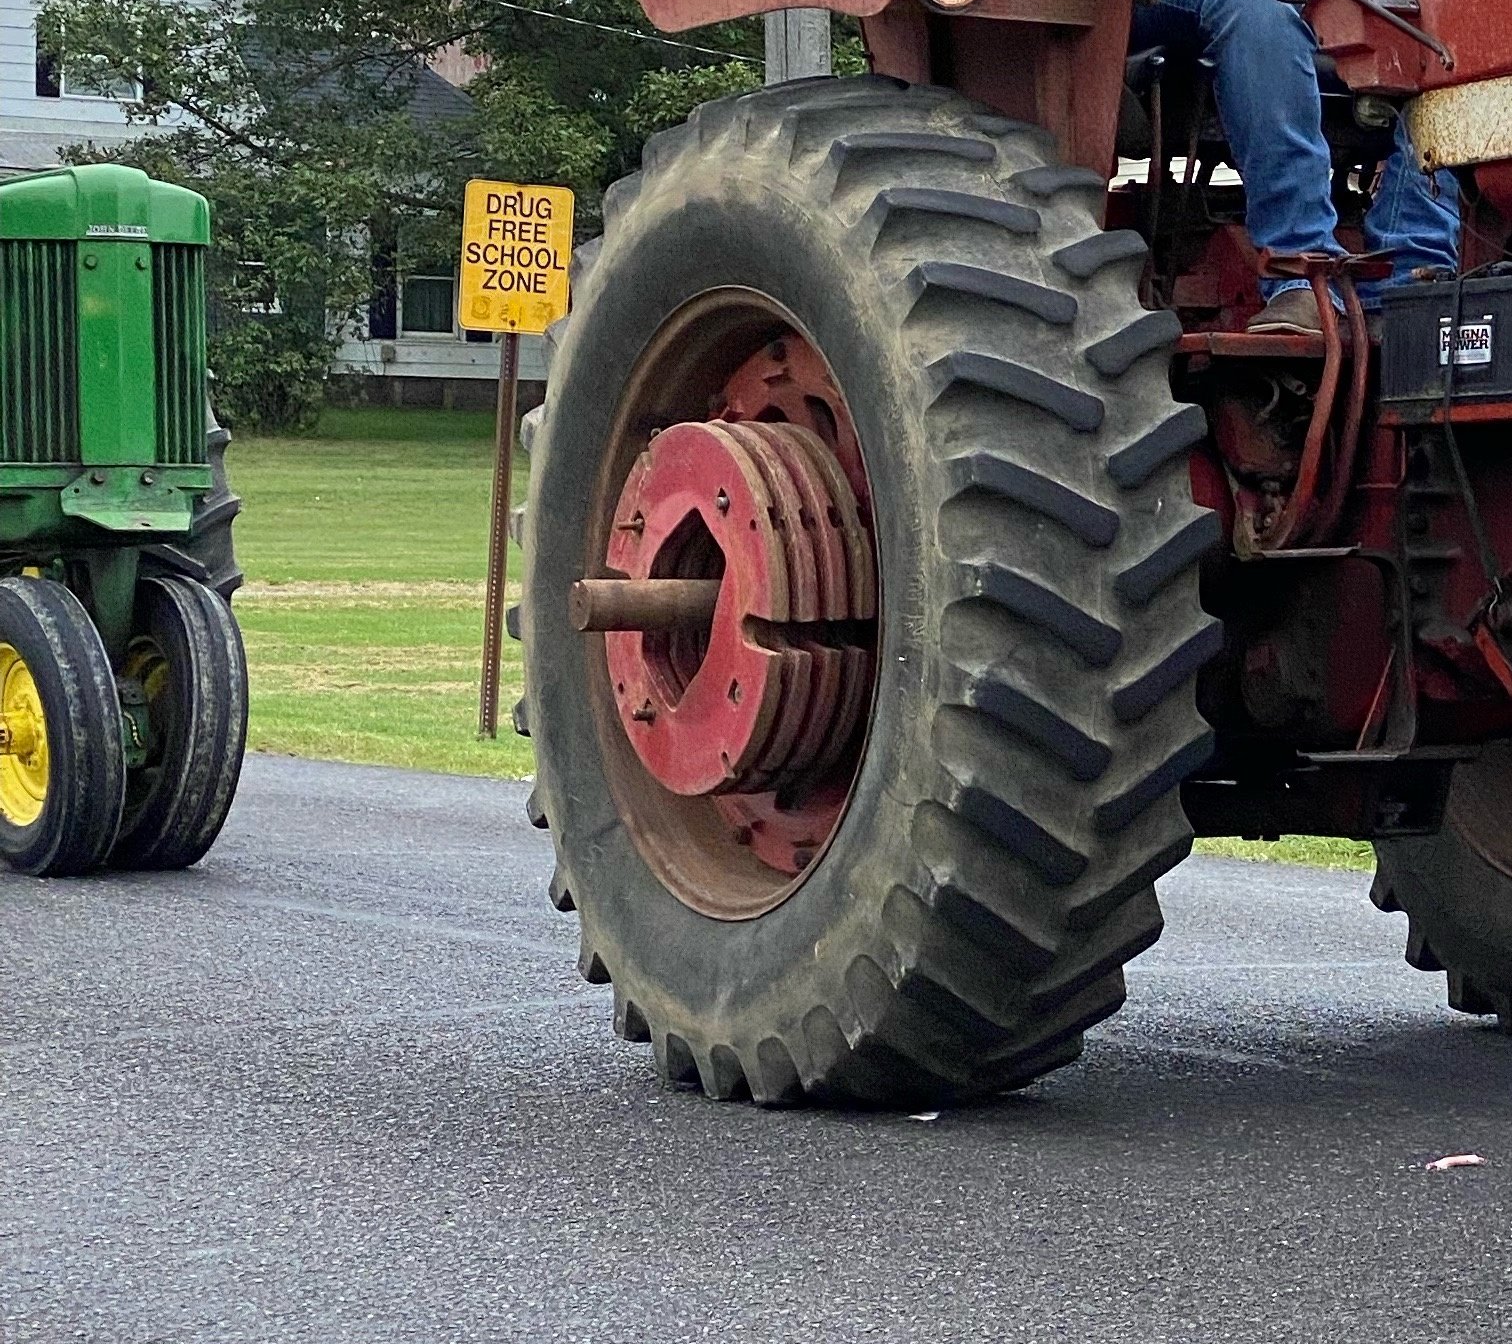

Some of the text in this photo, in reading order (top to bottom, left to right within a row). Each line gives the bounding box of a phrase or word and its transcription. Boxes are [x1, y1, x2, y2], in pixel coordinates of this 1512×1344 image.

[486, 193, 553, 220] DRUG
[488, 219, 548, 244] FREE
[466, 242, 566, 271] SCHOOL
[482, 269, 548, 294] ZONE
